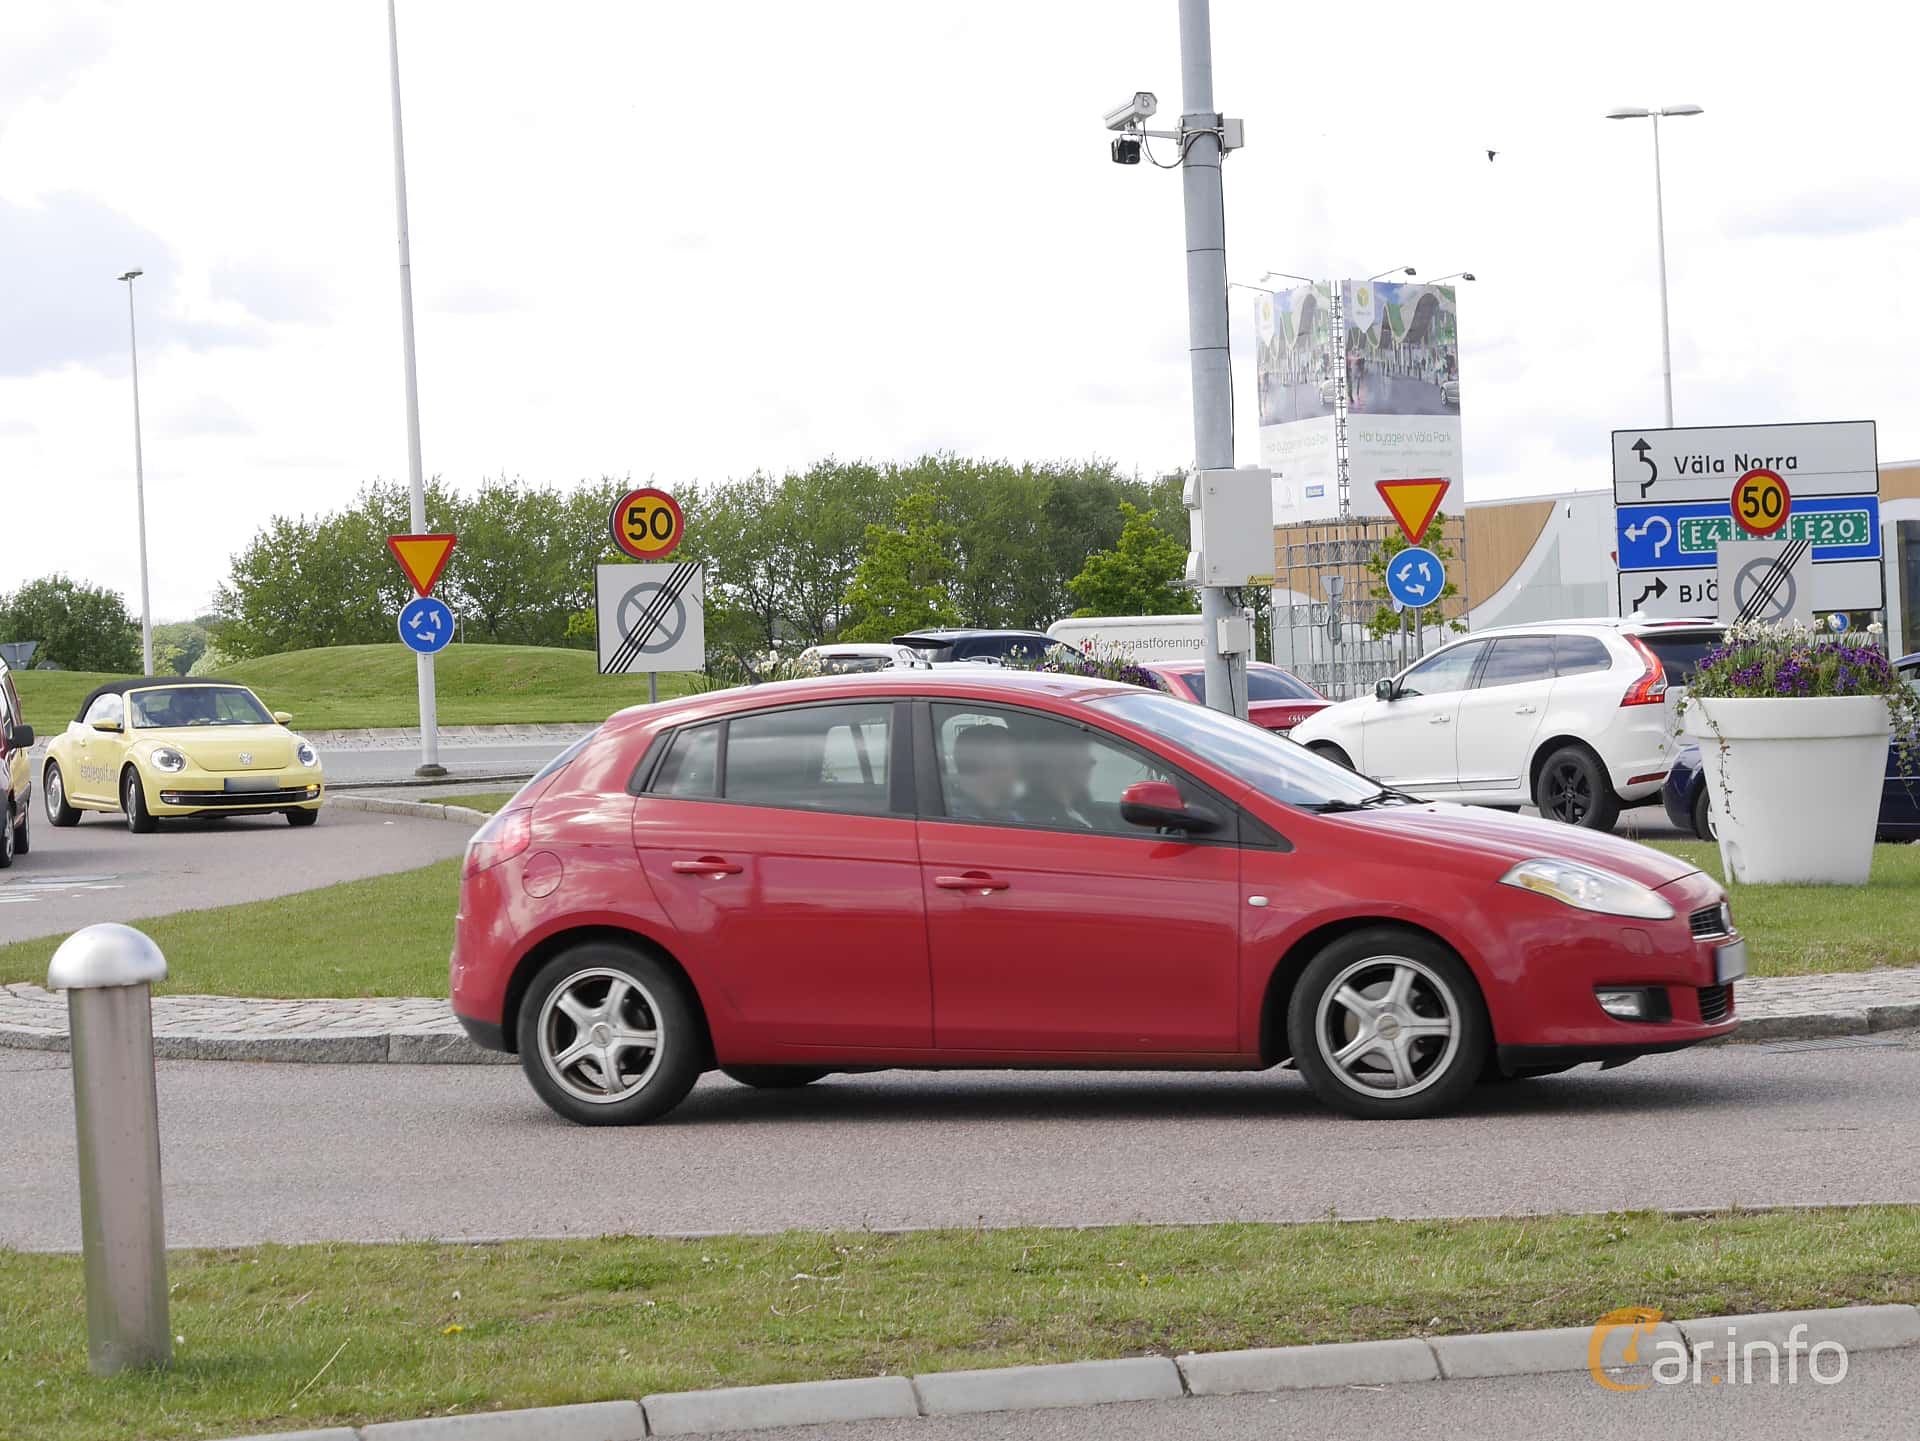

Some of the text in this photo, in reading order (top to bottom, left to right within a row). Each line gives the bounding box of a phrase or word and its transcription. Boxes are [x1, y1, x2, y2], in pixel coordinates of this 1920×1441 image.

[1674, 453, 1798, 474] Väla Norra
[1743, 486, 1782, 518] 50
[628, 507, 673, 540] 50
[1691, 524, 1721, 545] E4
[1805, 519, 1855, 541] E20
